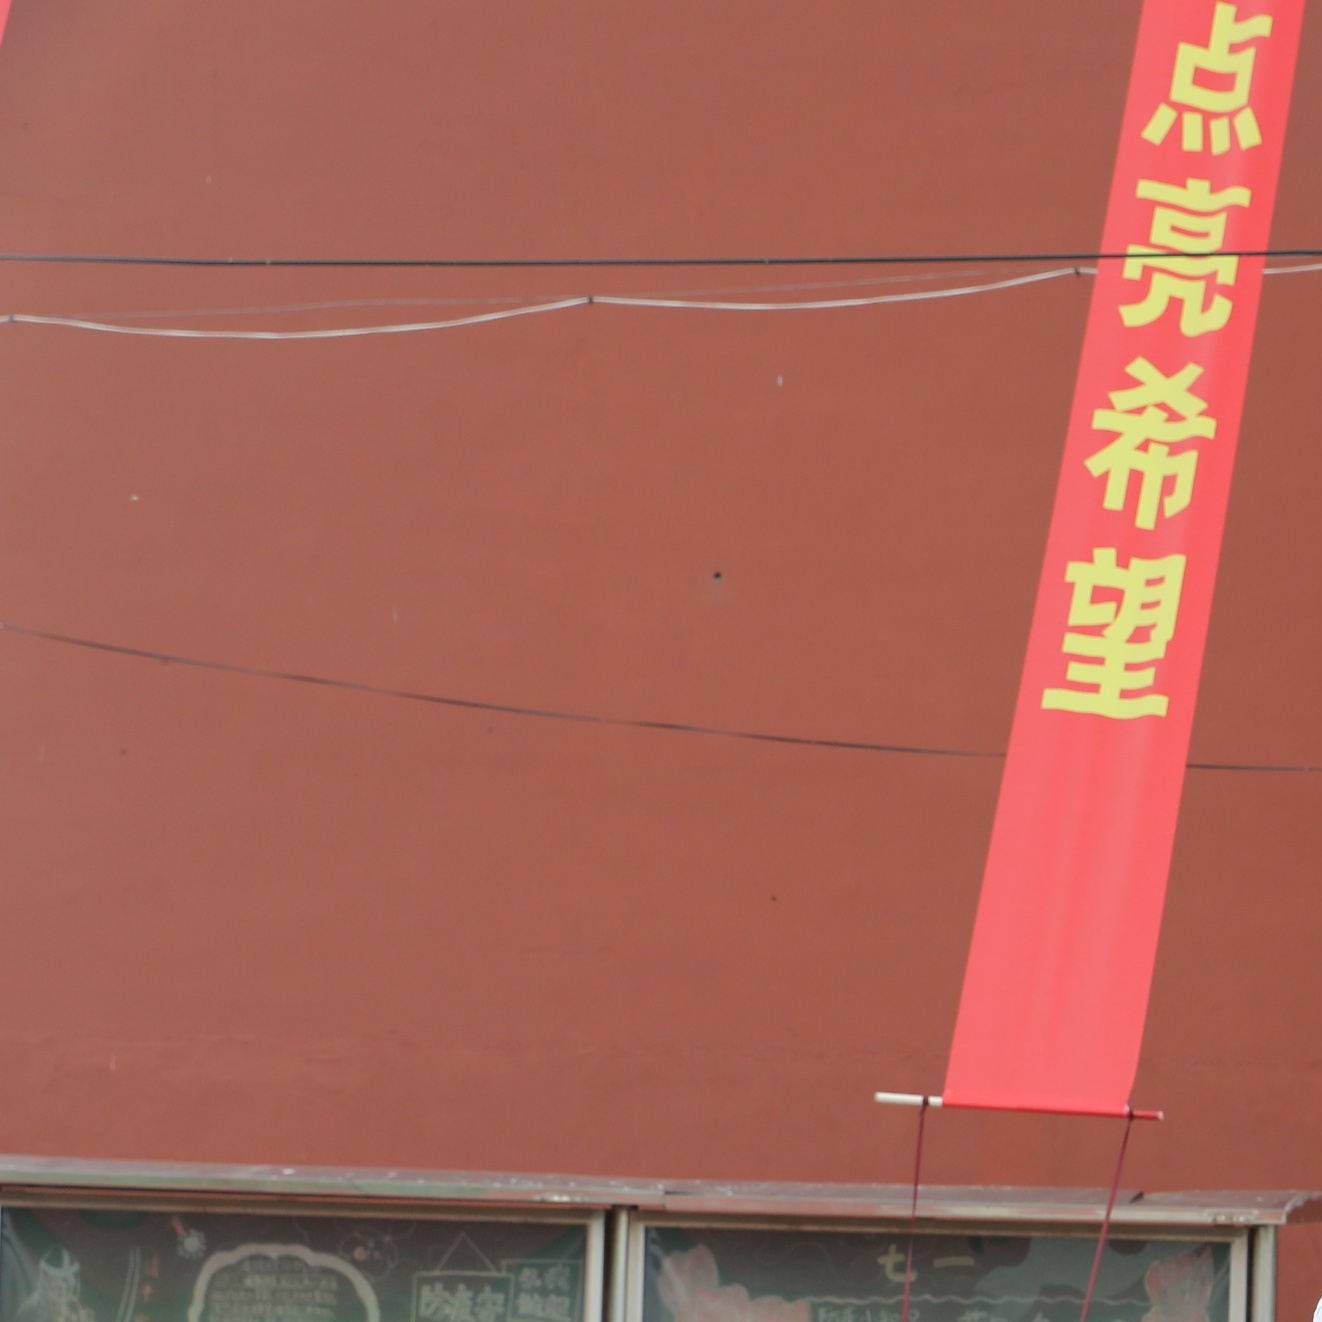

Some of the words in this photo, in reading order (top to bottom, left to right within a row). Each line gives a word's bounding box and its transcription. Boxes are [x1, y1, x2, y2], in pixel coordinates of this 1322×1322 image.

[1040, 1, 1274, 720] 点亮希望
[877, 1243, 976, 1283] 七一
